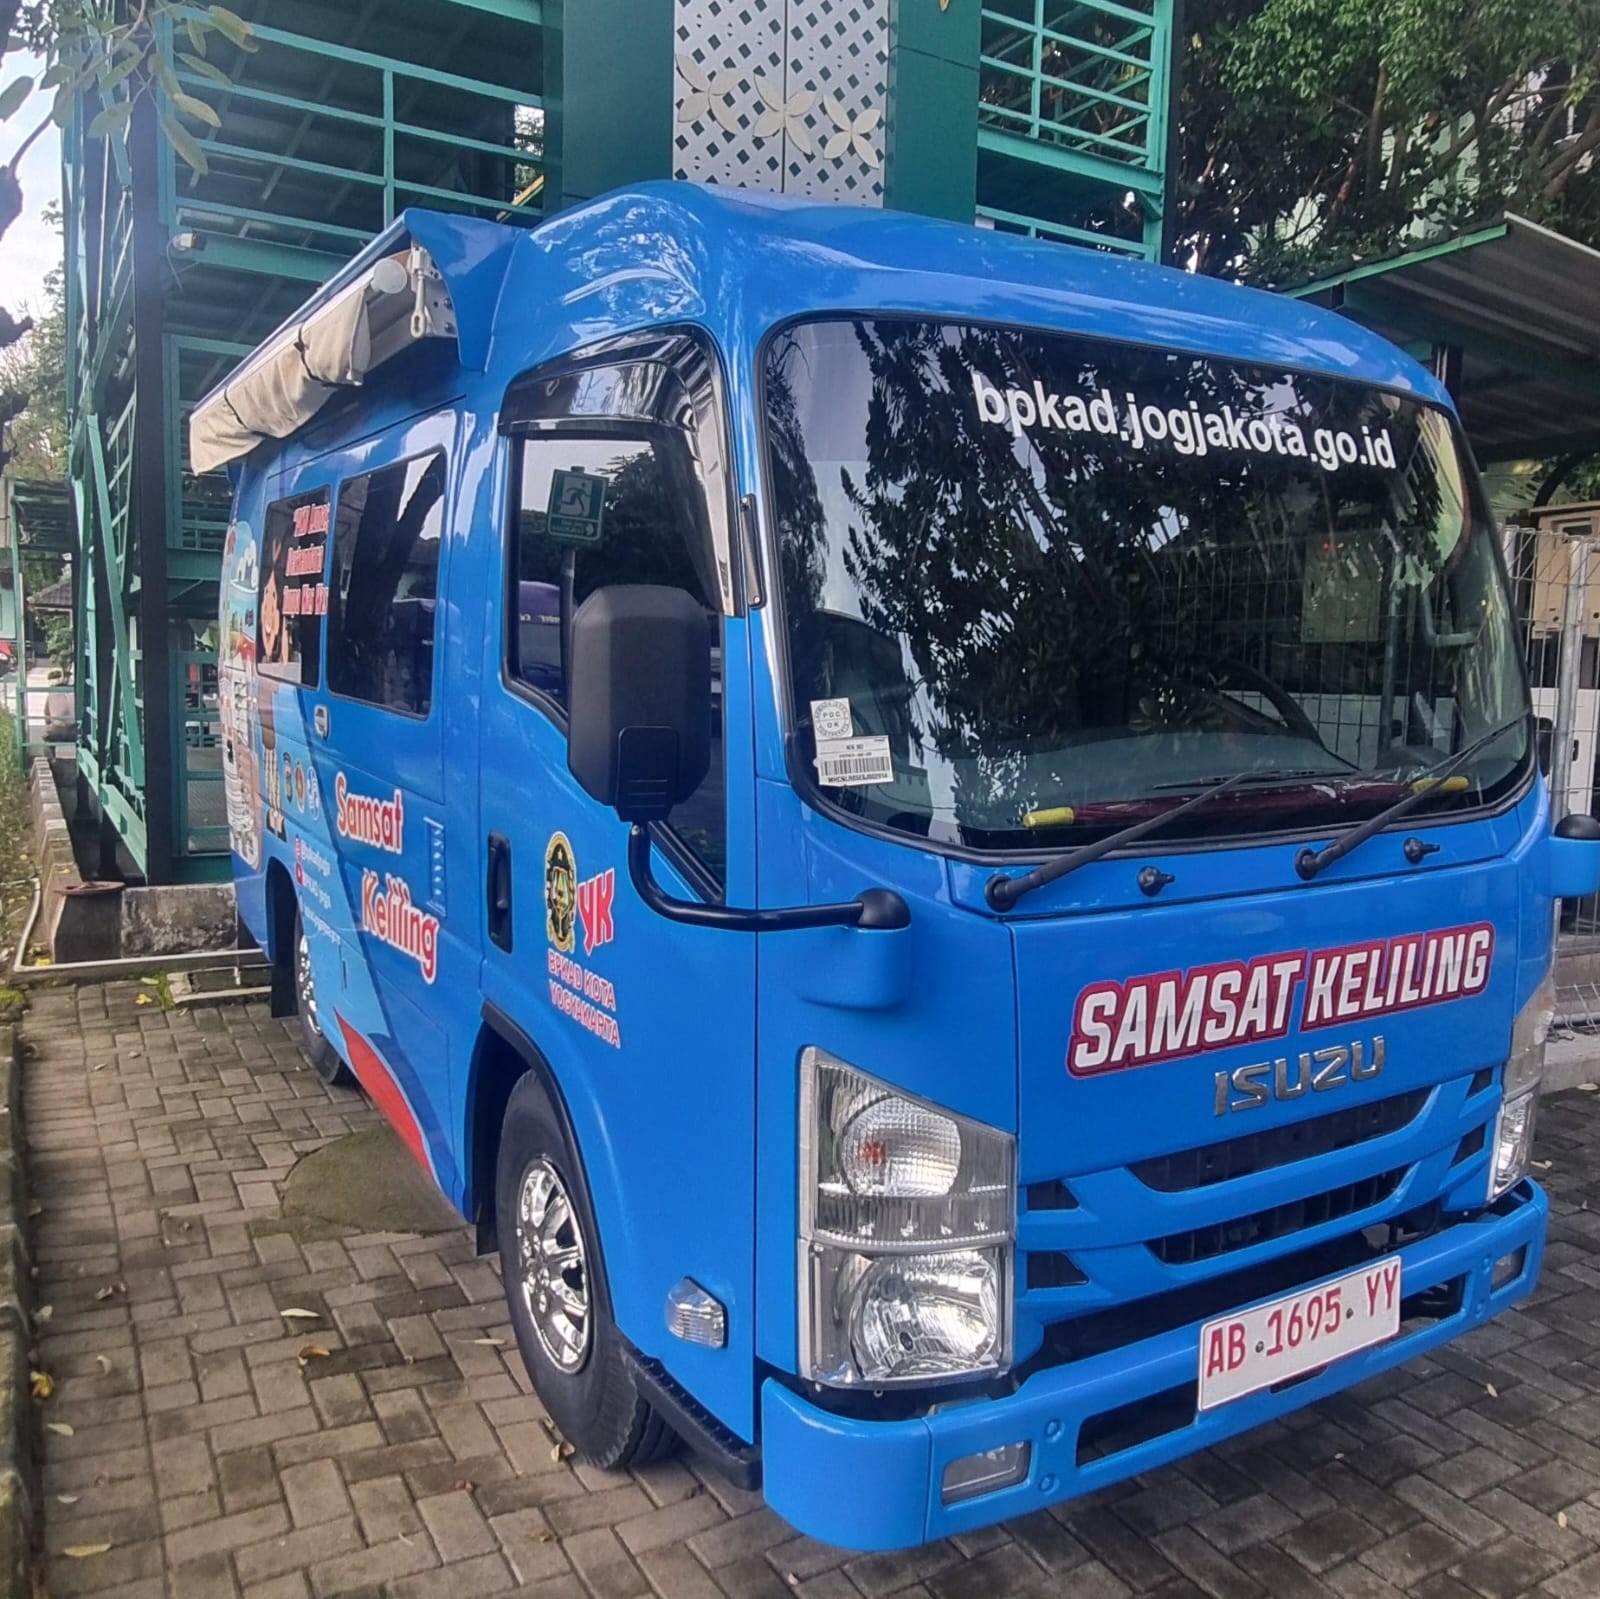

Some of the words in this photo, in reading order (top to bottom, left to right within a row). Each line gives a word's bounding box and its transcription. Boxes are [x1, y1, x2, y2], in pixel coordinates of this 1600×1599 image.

[972, 371, 1396, 471] bpkad.jogjakota.go.id
[336, 772, 403, 854] Samsat
[362, 868, 439, 984] Keliling
[548, 948, 583, 991] BPKAD
[584, 969, 616, 1012] KOTA
[549, 979, 621, 1049] YOGYAKARTA
[1068, 951, 1305, 1076] SAMSAT
[1302, 923, 1494, 1031] KELILING
[1213, 1036, 1385, 1117] ISUZU
[1206, 1321, 1246, 1378] AB
[1265, 1286, 1342, 1357] 1695
[1365, 1263, 1399, 1318] YY
